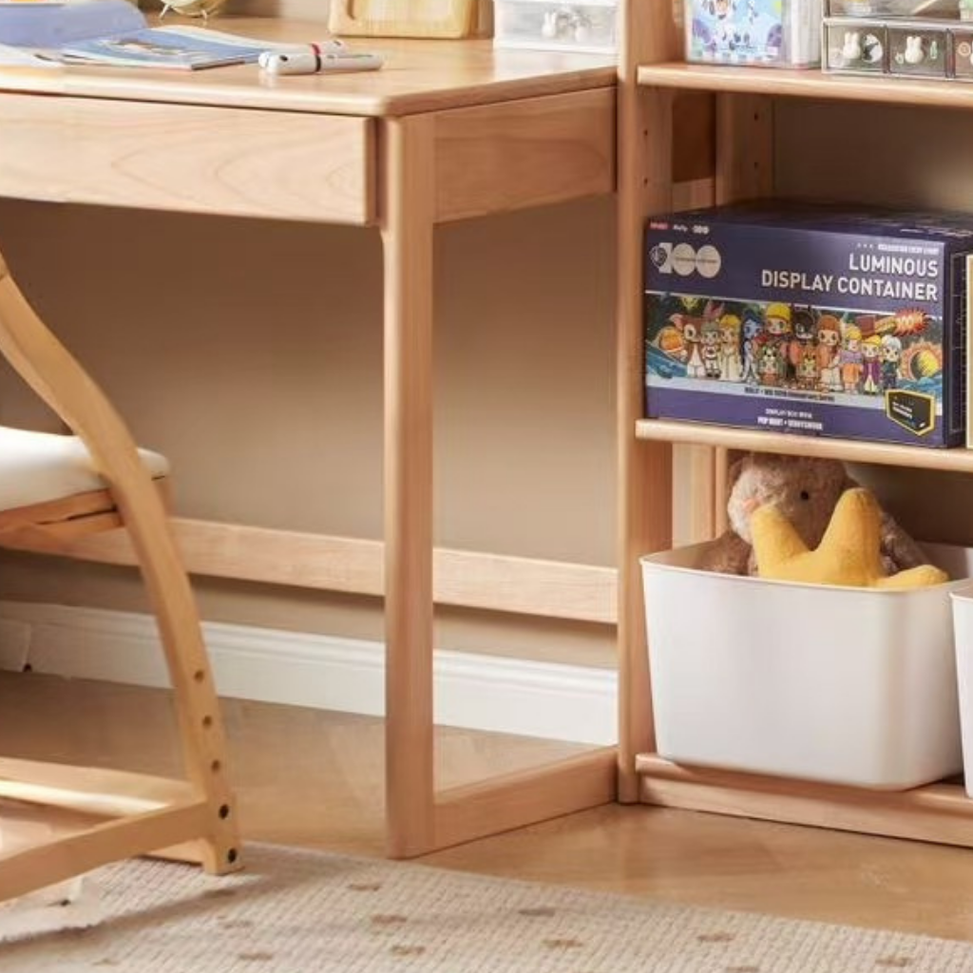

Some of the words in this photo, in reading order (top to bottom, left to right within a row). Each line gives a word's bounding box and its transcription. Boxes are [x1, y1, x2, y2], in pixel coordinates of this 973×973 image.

[849, 253, 939, 277] LUMINOUS
[761, 269, 834, 293] DISPLAY
[837, 277, 939, 302] CONTAINER
